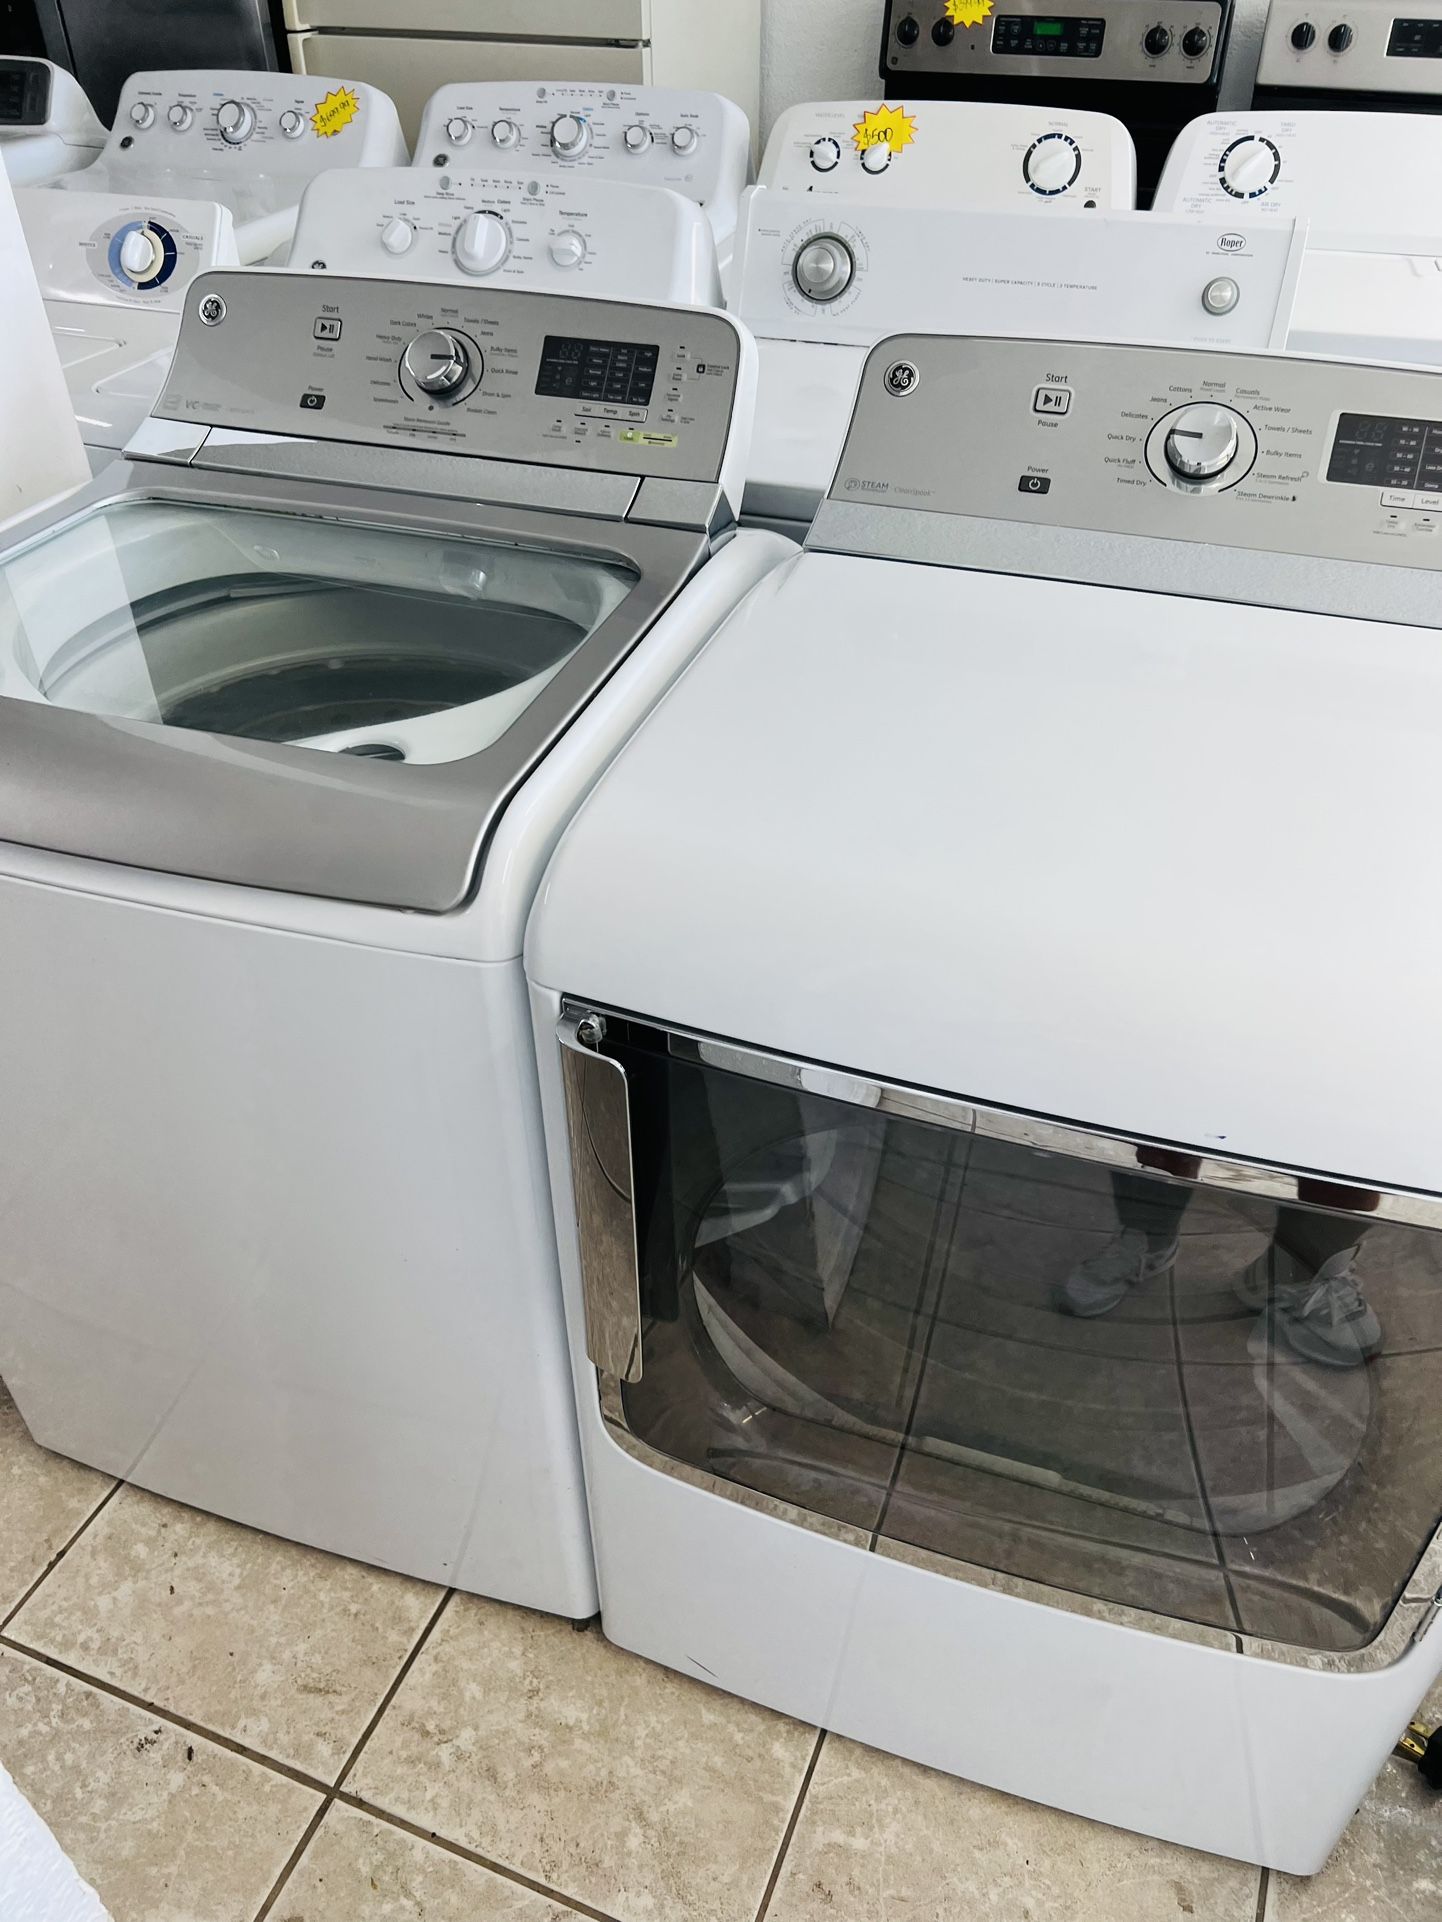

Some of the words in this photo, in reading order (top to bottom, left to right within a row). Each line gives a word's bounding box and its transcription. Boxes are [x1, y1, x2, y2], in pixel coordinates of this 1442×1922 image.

[1220, 236, 1243, 249] Roper
[321, 304, 341, 314] Start
[1045, 372, 1068, 384] Start
[1202, 380, 1226, 389] Normal
[1168, 386, 1193, 394] Cottons
[1236, 388, 1260, 396] Casuals
[1150, 396, 1168, 404] Jeans
[603, 407, 618, 416] Temp
[628, 410, 641, 418] Spin
[1252, 404, 1273, 412] Active
[1274, 406, 1292, 414] Wear
[1120, 410, 1148, 420] Delicates
[1037, 419, 1059, 428] Pause
[1264, 424, 1286, 432] Towels
[1290, 426, 1313, 435] Sheets
[1108, 433, 1124, 441] Quick
[1126, 435, 1137, 443] Dry
[1266, 450, 1283, 458] Bulky
[1284, 452, 1303, 460] Items
[1104, 456, 1121, 464] Quick
[1122, 458, 1137, 466] Fluff
[1027, 466, 1049, 474] Power
[1256, 472, 1276, 480] Steam
[1278, 474, 1302, 482] Refresh
[861, 480, 889, 490] STEAM
[1116, 477, 1134, 485] Timed
[1136, 480, 1147, 488] Dry
[1237, 490, 1258, 498] Steam
[1258, 493, 1290, 502] Dewrinkle
[1389, 494, 1406, 502] Time
[1420, 498, 1440, 506] Level
